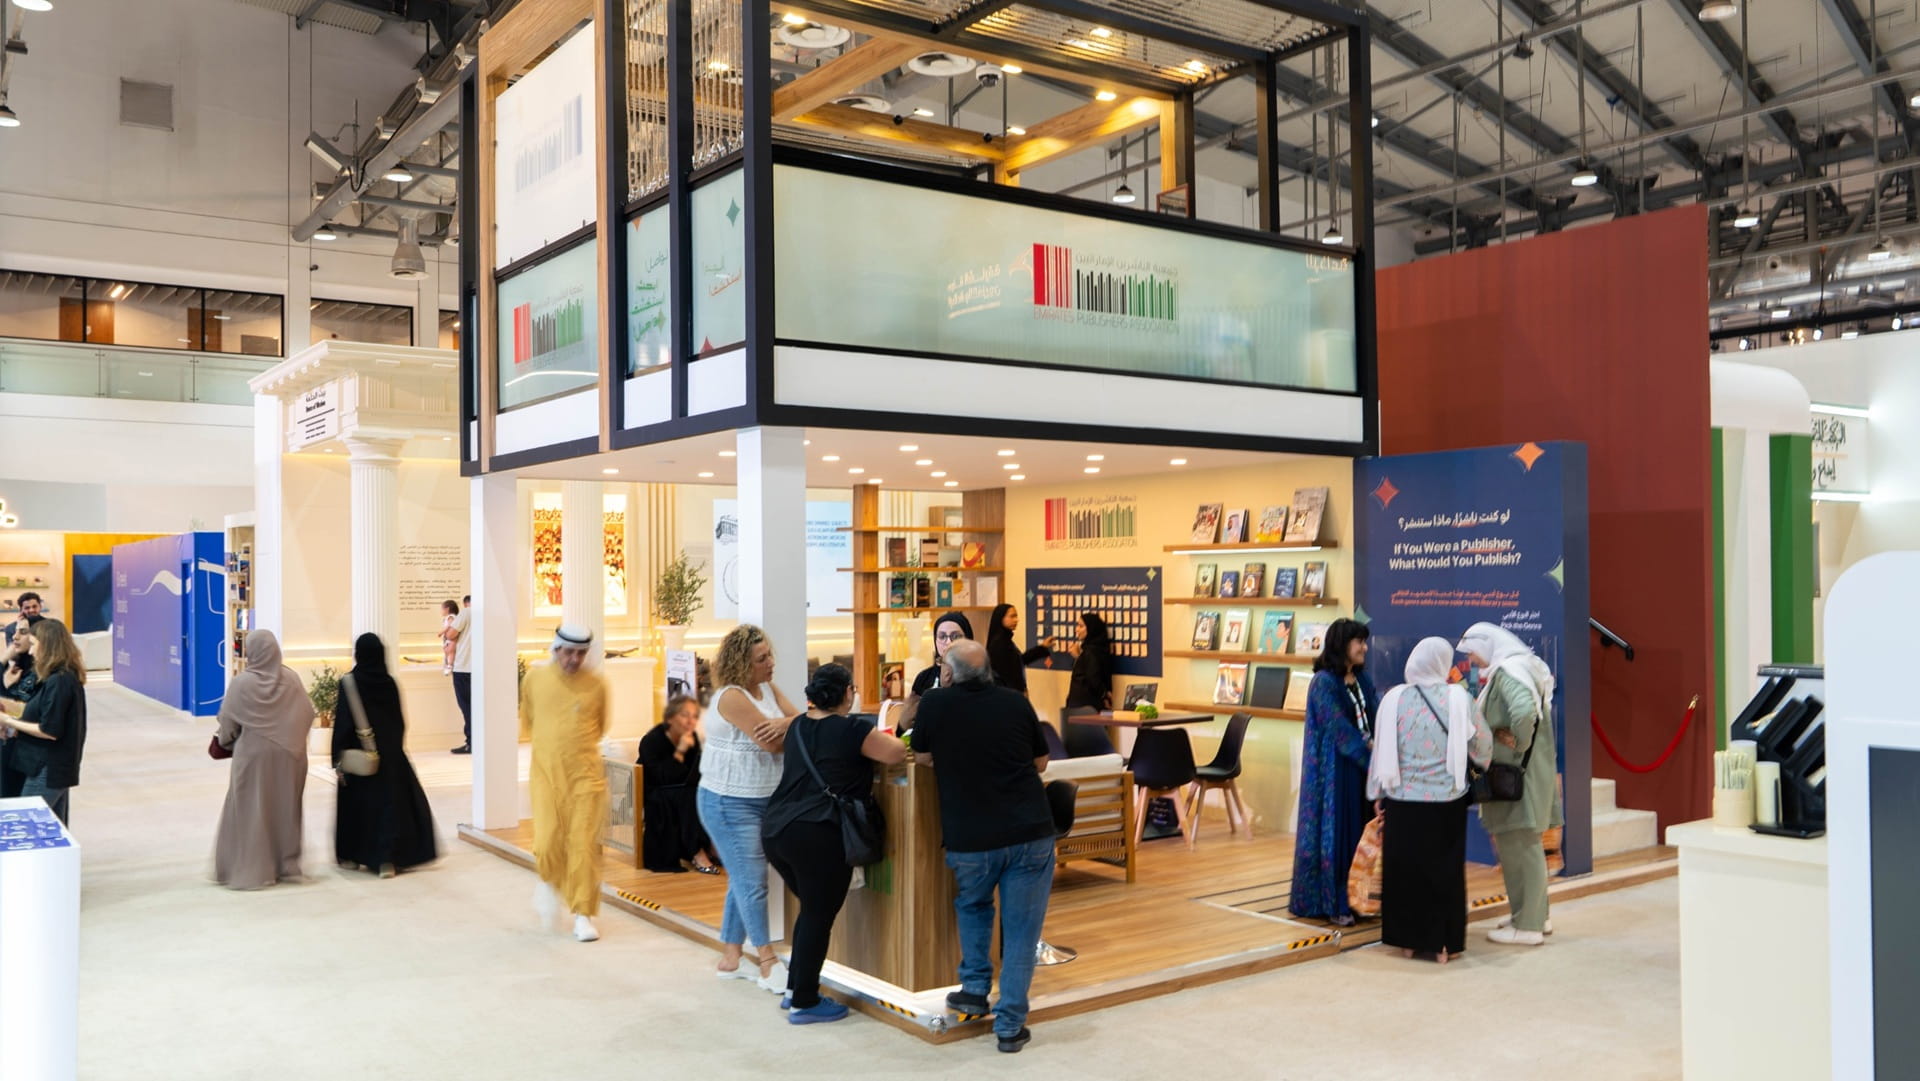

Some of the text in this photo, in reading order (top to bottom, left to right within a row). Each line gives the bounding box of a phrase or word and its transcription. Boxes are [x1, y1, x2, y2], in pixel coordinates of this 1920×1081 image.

[1398, 516, 1433, 532] ستنشر؟
[1433, 513, 1452, 527] ماذا
[1479, 510, 1500, 524] كنت
[1500, 508, 1511, 525] لو
[1393, 537, 1516, 555] If You Were a Publisher,
[1389, 552, 1522, 570] What Would You Publish?
